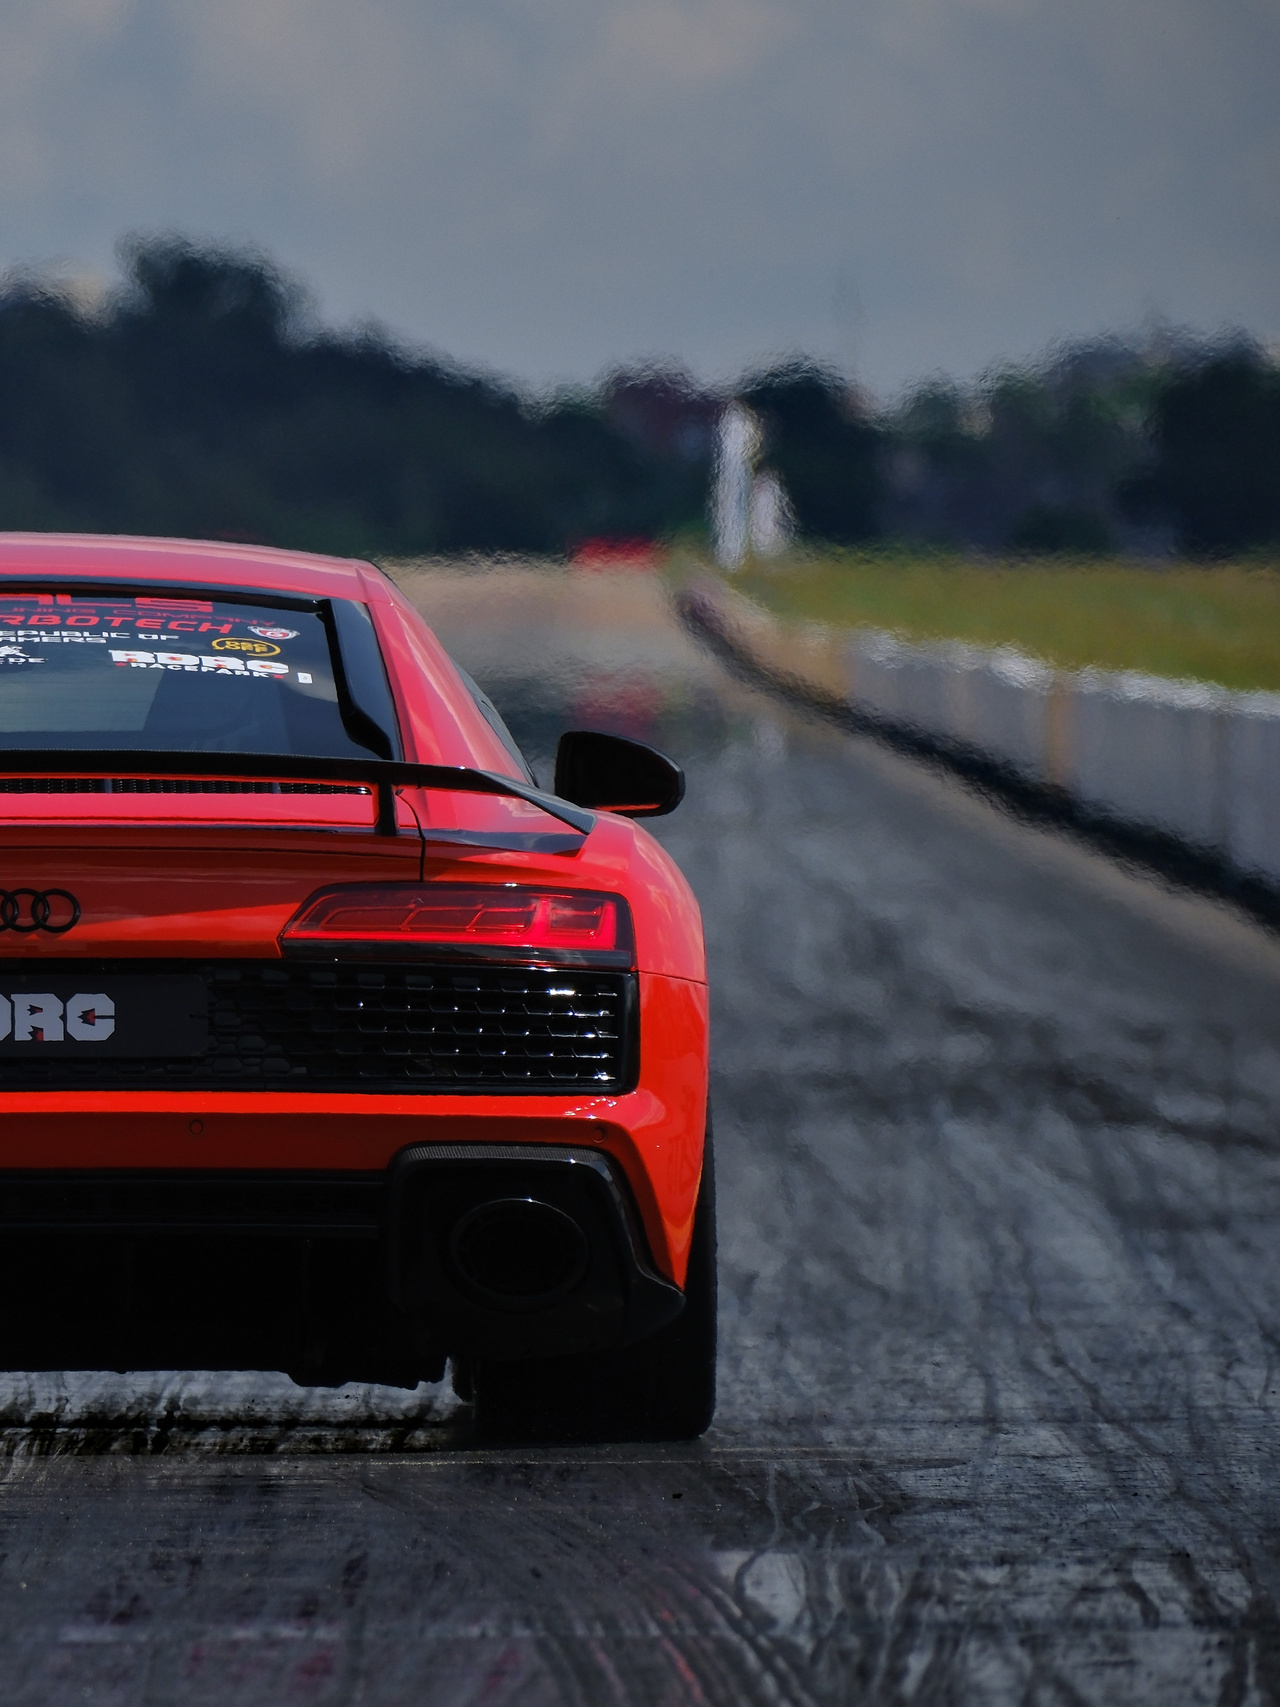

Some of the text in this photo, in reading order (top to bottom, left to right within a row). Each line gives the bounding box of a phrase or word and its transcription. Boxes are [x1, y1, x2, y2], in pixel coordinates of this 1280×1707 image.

[113, 609, 276, 626] COMPANY
[108, 649, 289, 674] RDRC
[130, 662, 270, 678] RACEPARK
